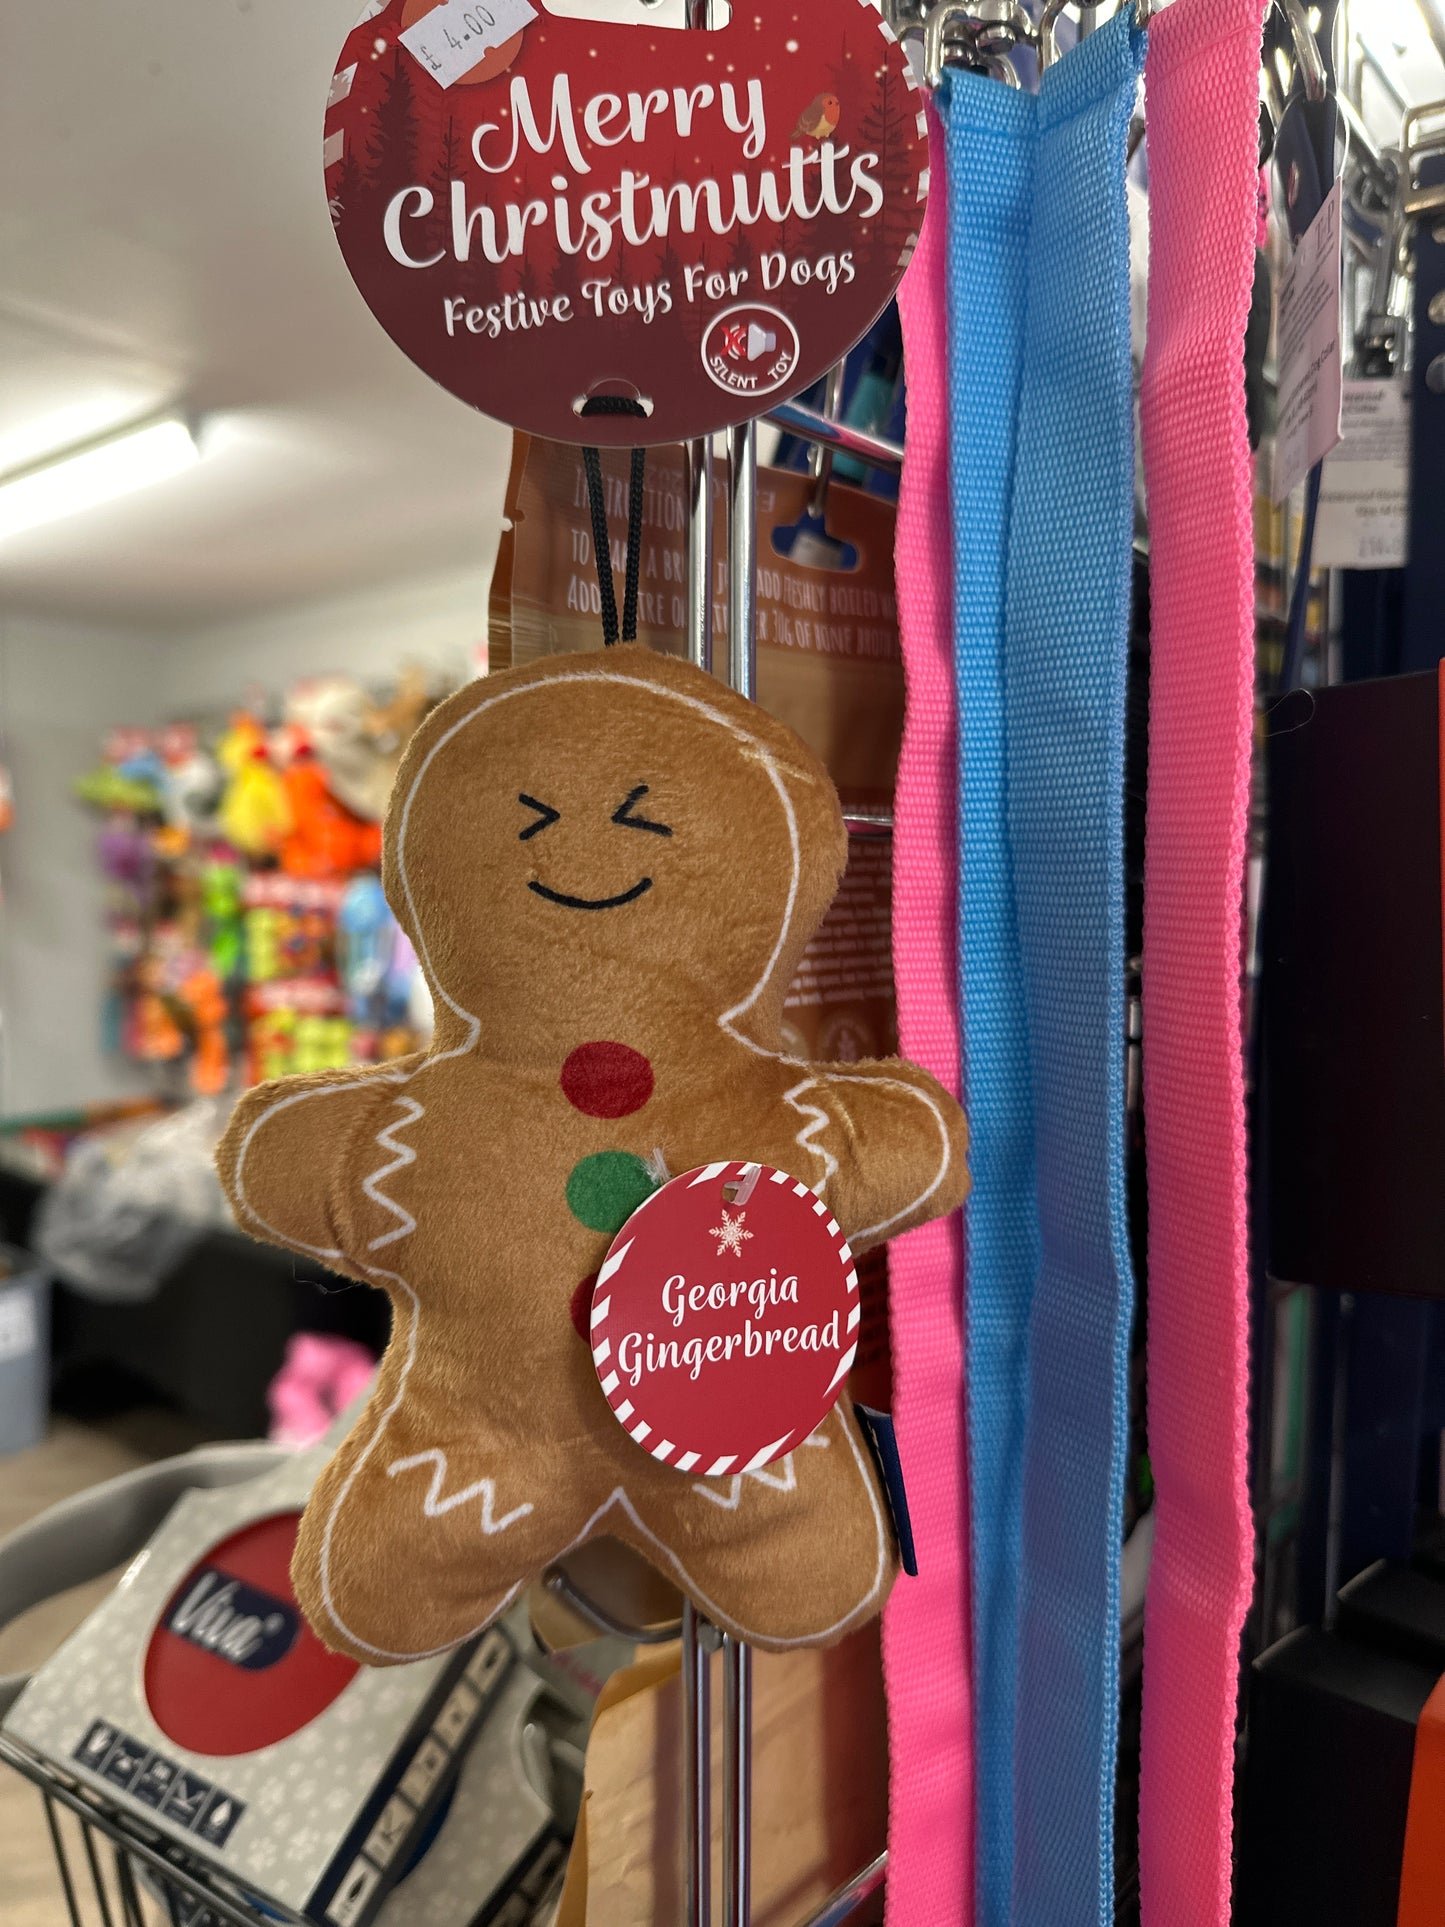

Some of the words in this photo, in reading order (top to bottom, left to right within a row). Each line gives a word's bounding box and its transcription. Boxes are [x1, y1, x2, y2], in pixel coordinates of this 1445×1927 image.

[443, 5, 495, 50] 4.00
[472, 73, 766, 174] Merry
[383, 142, 885, 269] Christmutts
[444, 292, 574, 338] Festive
[582, 277, 672, 324] Toys
[683, 265, 748, 303] For
[761, 251, 856, 295] Dogs
[710, 356, 758, 389] SILENT
[767, 351, 793, 380] TOY
[571, 528, 590, 566] TO
[646, 547, 657, 579] A
[567, 574, 600, 615] ADD
[795, 619, 810, 650] OF
[662, 1268, 799, 1327] Georgia
[618, 1309, 840, 1387] Gingerbread
